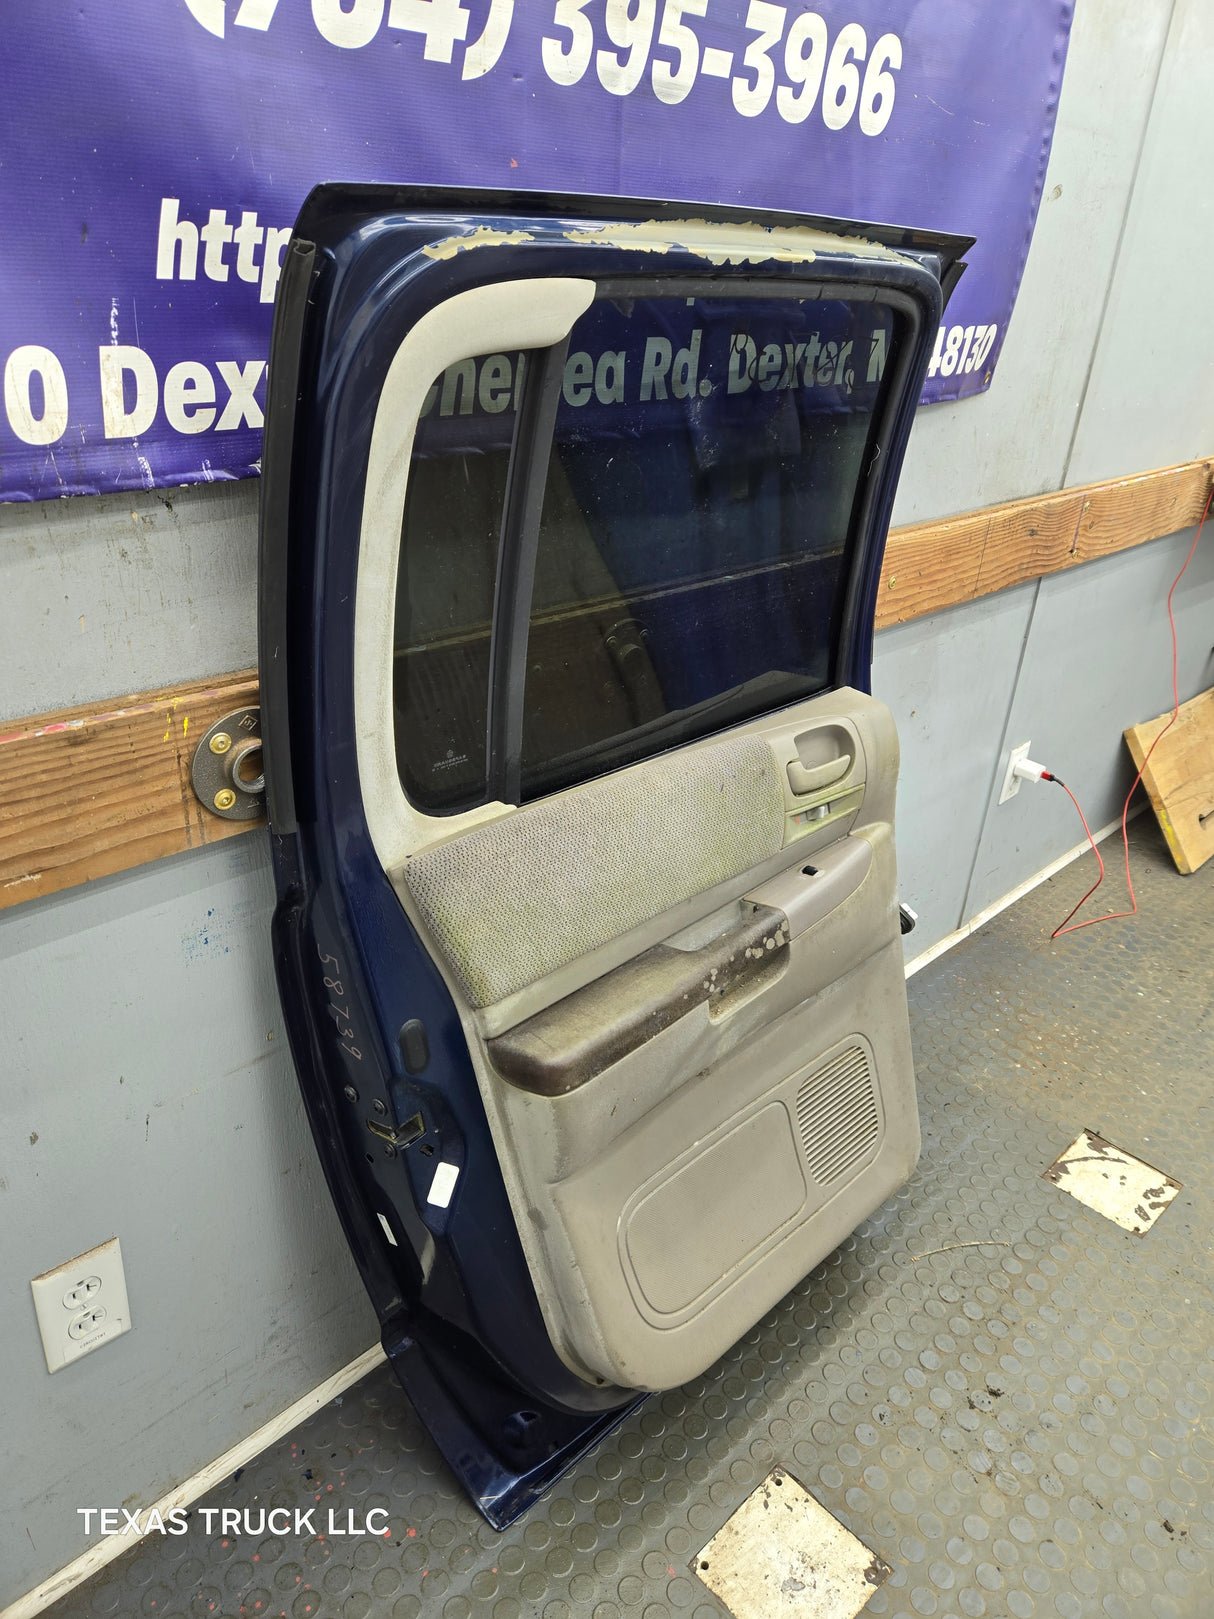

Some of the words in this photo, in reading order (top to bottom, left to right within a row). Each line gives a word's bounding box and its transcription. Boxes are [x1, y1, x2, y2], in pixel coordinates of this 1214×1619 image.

[541, 0, 903, 137] 395-3966
[99, 345, 269, 440] Dex
[640, 329, 712, 401] Rd.
[728, 331, 854, 396] Dexter,
[928, 323, 998, 378] 48130
